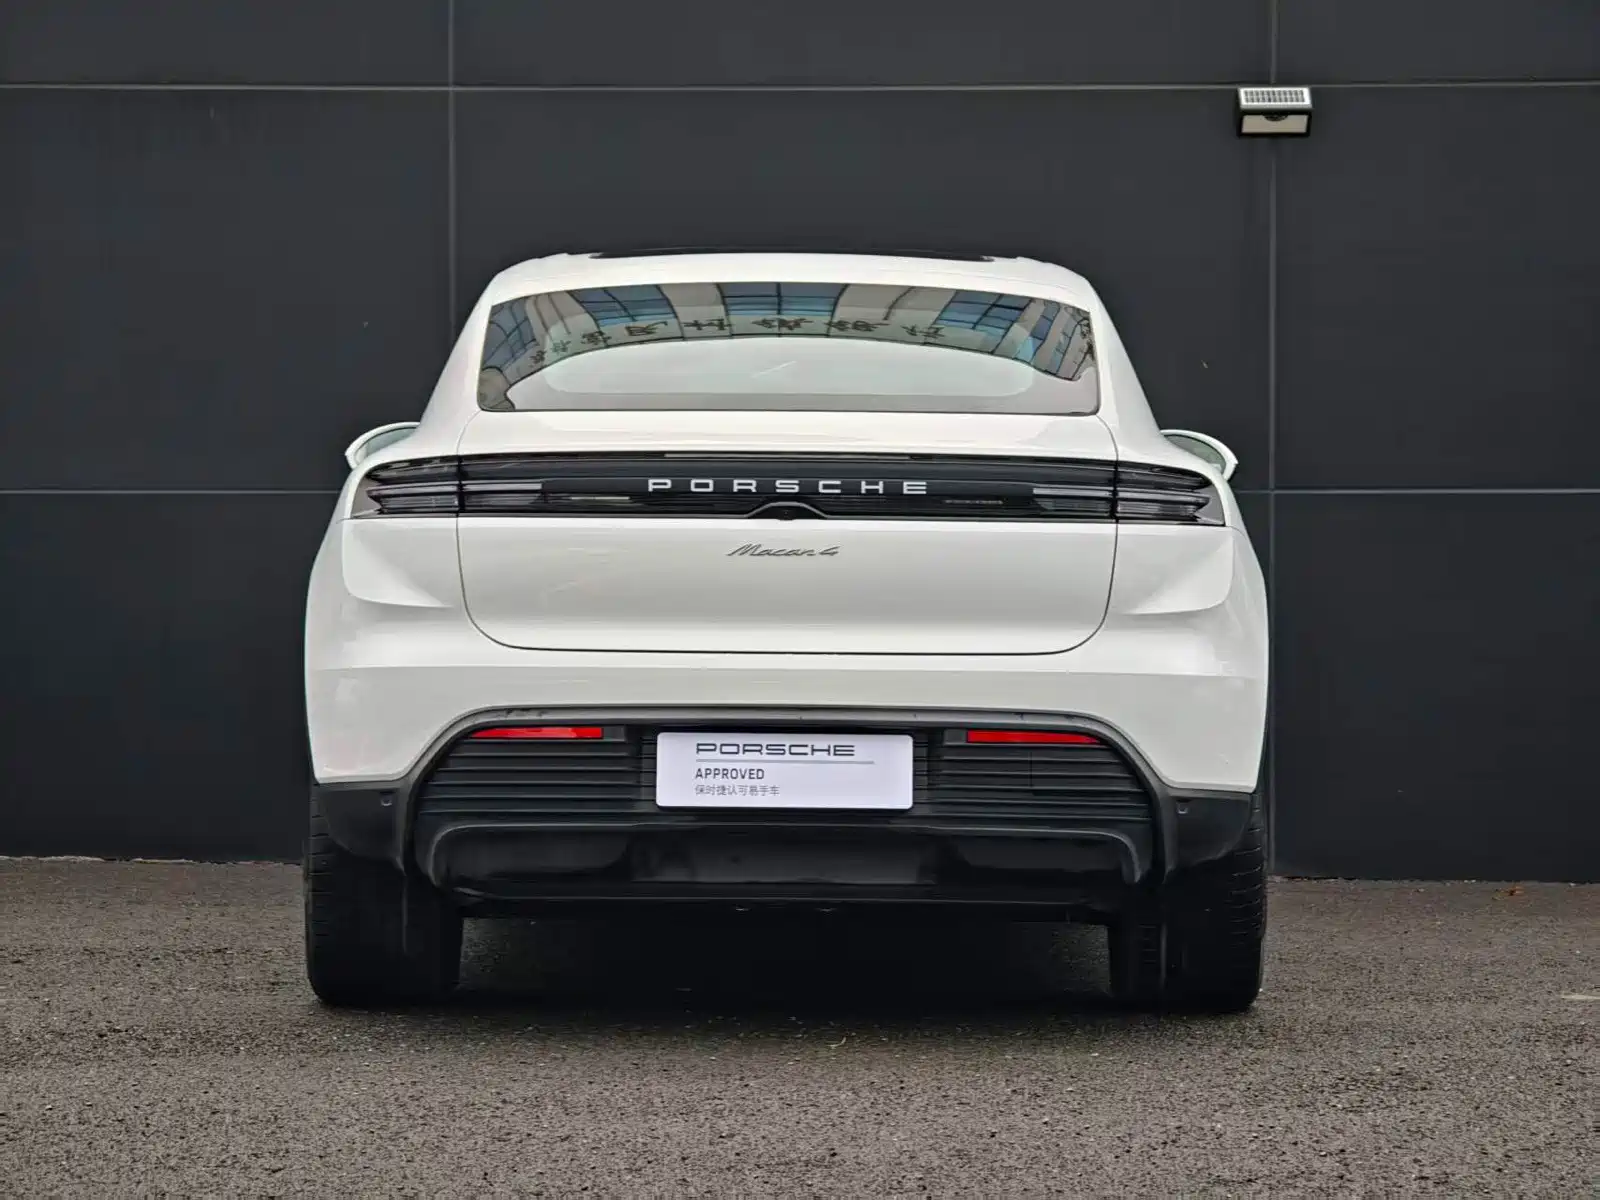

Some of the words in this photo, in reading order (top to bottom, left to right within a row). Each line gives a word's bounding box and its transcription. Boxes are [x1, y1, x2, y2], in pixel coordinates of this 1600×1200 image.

[647, 478, 928, 495] PORSCHE
[726, 543, 816, 557] Macan
[696, 742, 856, 757] PORSCHE
[695, 768, 765, 780] APPROVED
[695, 784, 780, 796] 保时捷认可易手车
